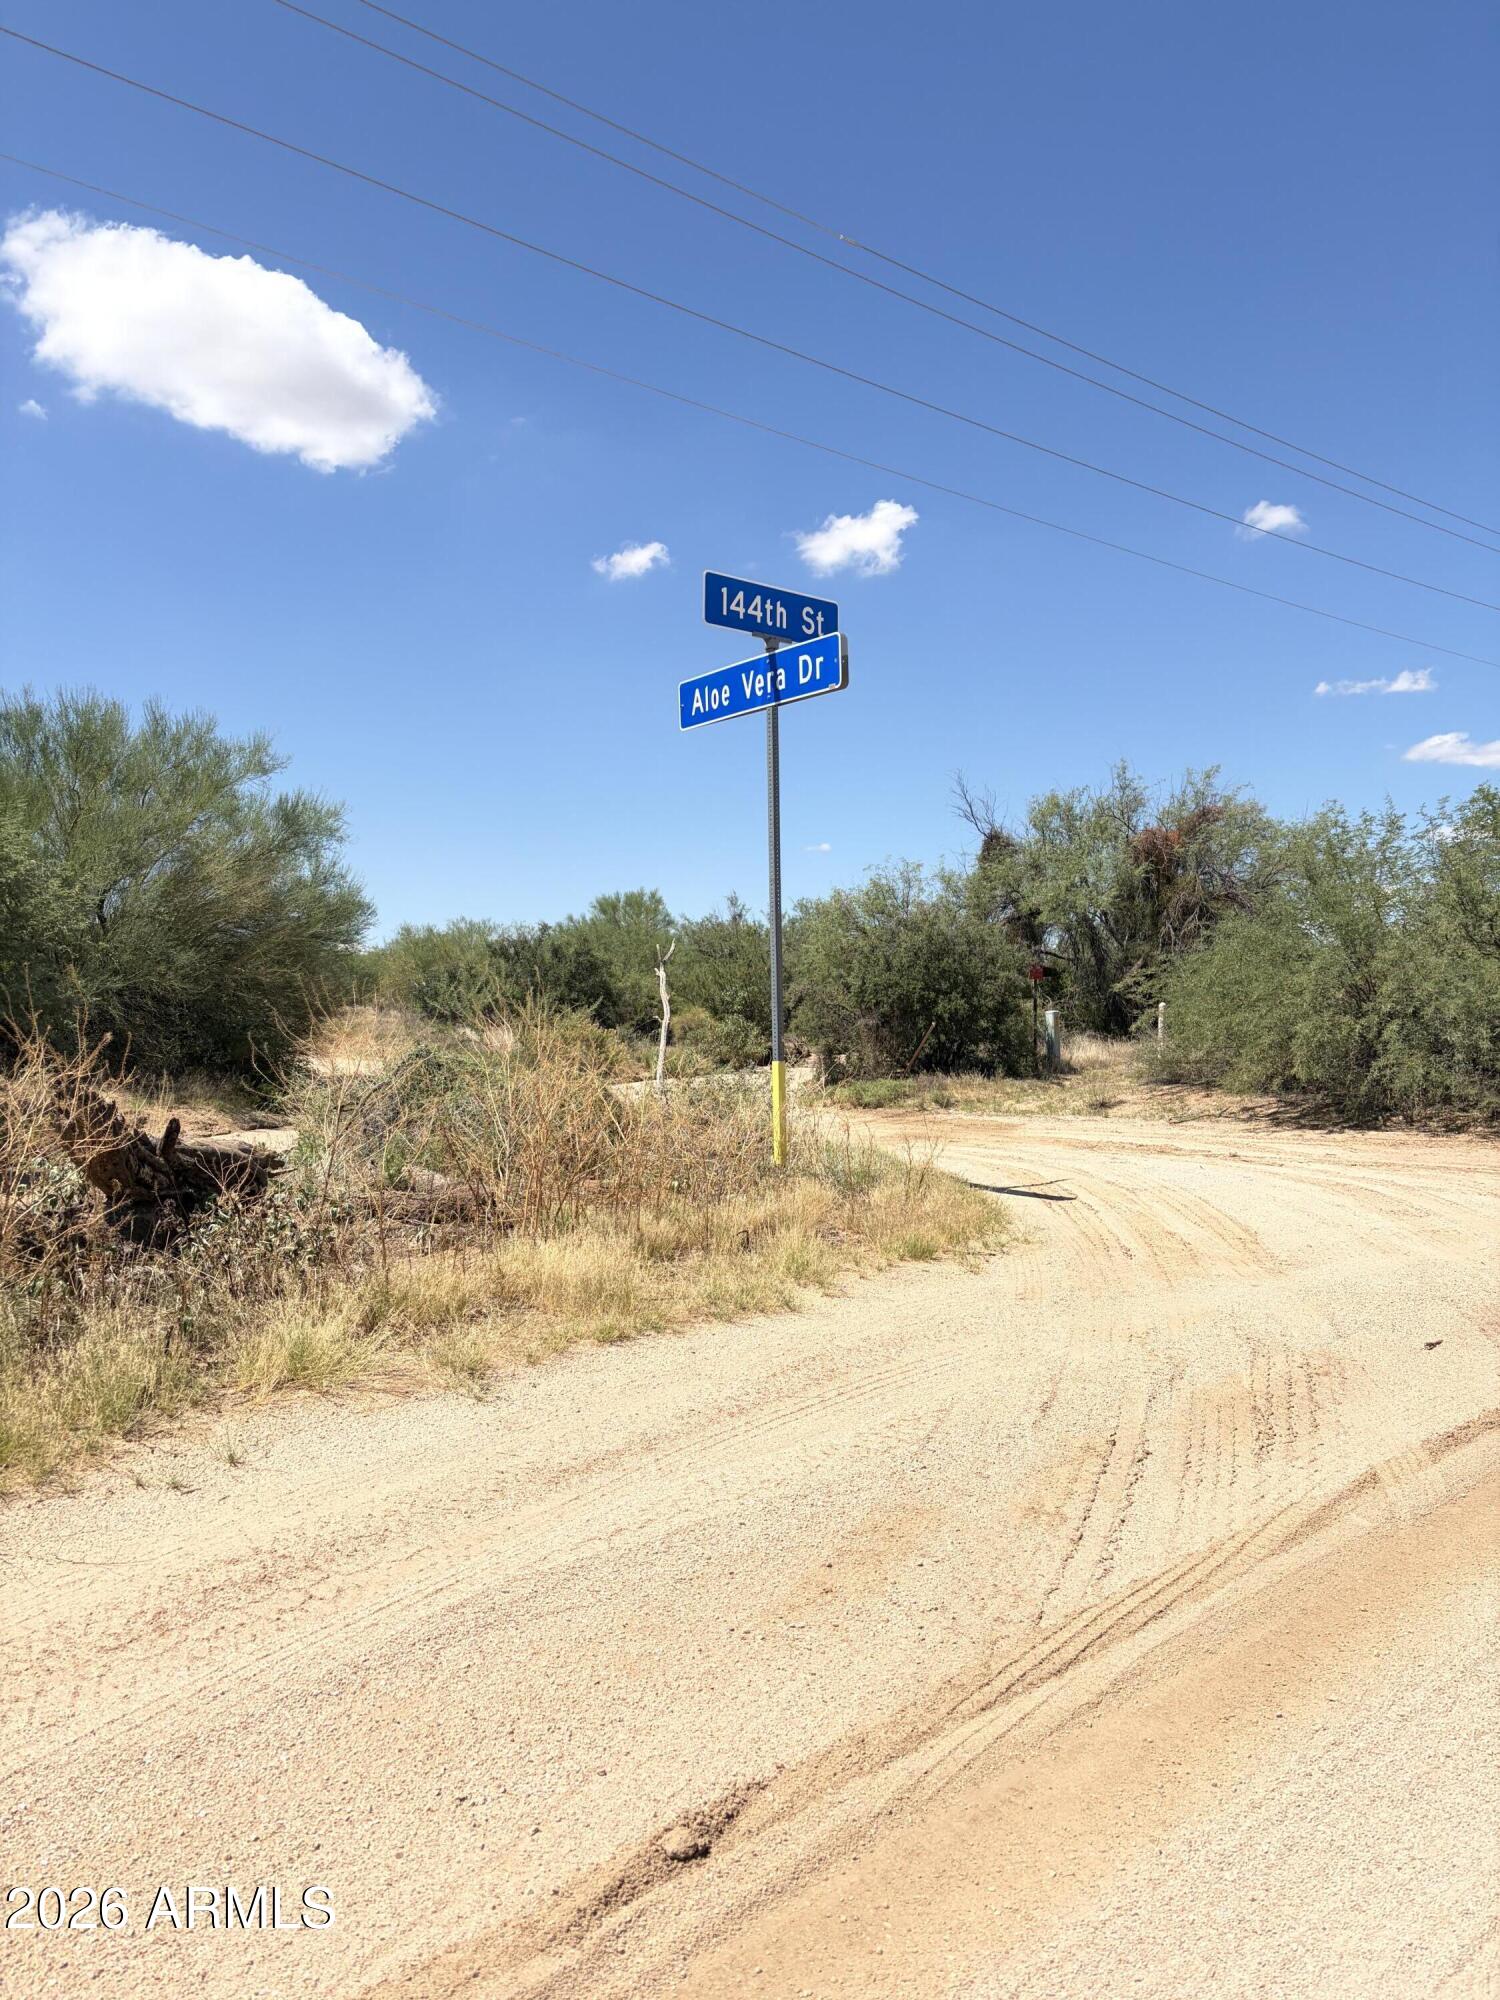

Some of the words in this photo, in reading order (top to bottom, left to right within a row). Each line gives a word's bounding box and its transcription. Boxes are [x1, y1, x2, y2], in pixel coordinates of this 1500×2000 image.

[721, 586, 787, 629] 144th
[801, 606, 825, 636] St
[691, 683, 731, 716] Aloe
[741, 667, 786, 700] Vera
[798, 654, 825, 685] Dr
